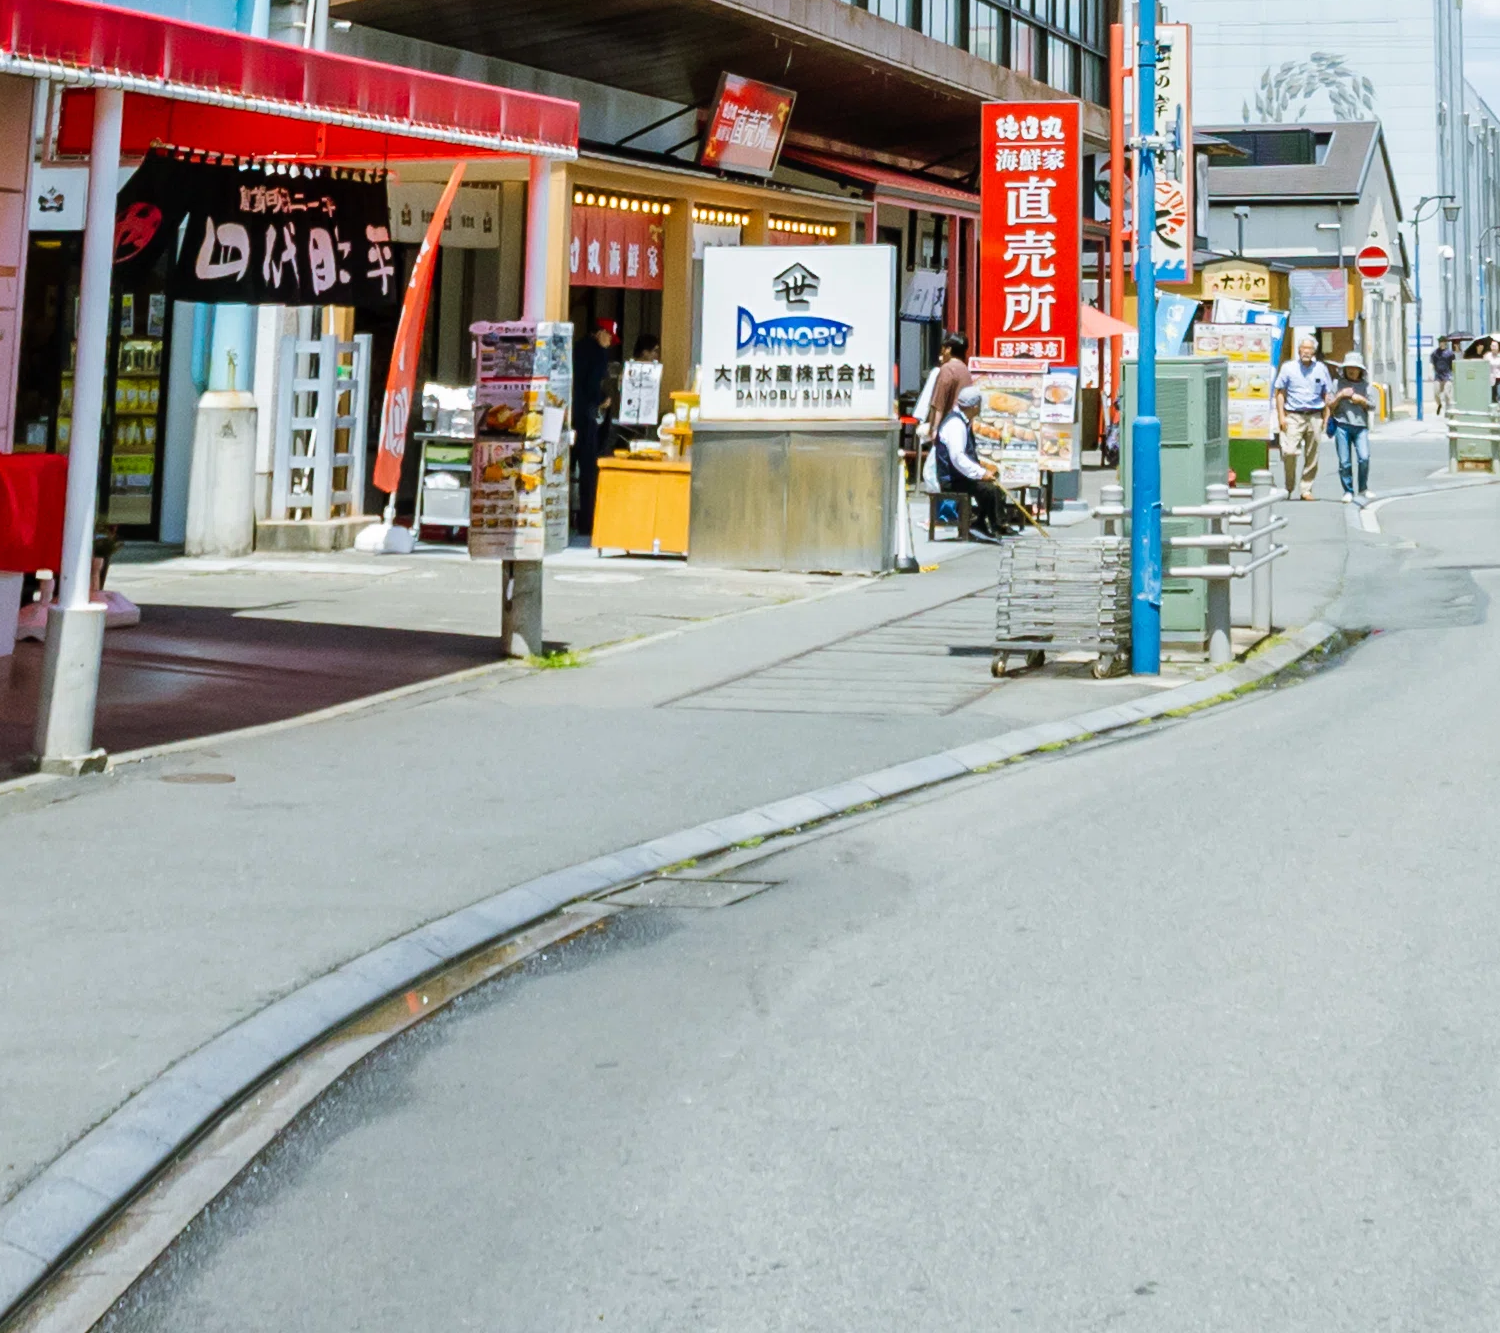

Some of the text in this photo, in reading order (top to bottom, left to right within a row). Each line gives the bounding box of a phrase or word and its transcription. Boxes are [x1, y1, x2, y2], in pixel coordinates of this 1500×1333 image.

[728, 105, 774, 148] 直売所
[995, 147, 1066, 172] 海鮮家
[1003, 176, 1057, 332] 直売所
[736, 305, 853, 351] DAINOBU
[714, 364, 875, 383] 大信水産株式会社
[736, 389, 852, 401] DAINOBU SUISAN
